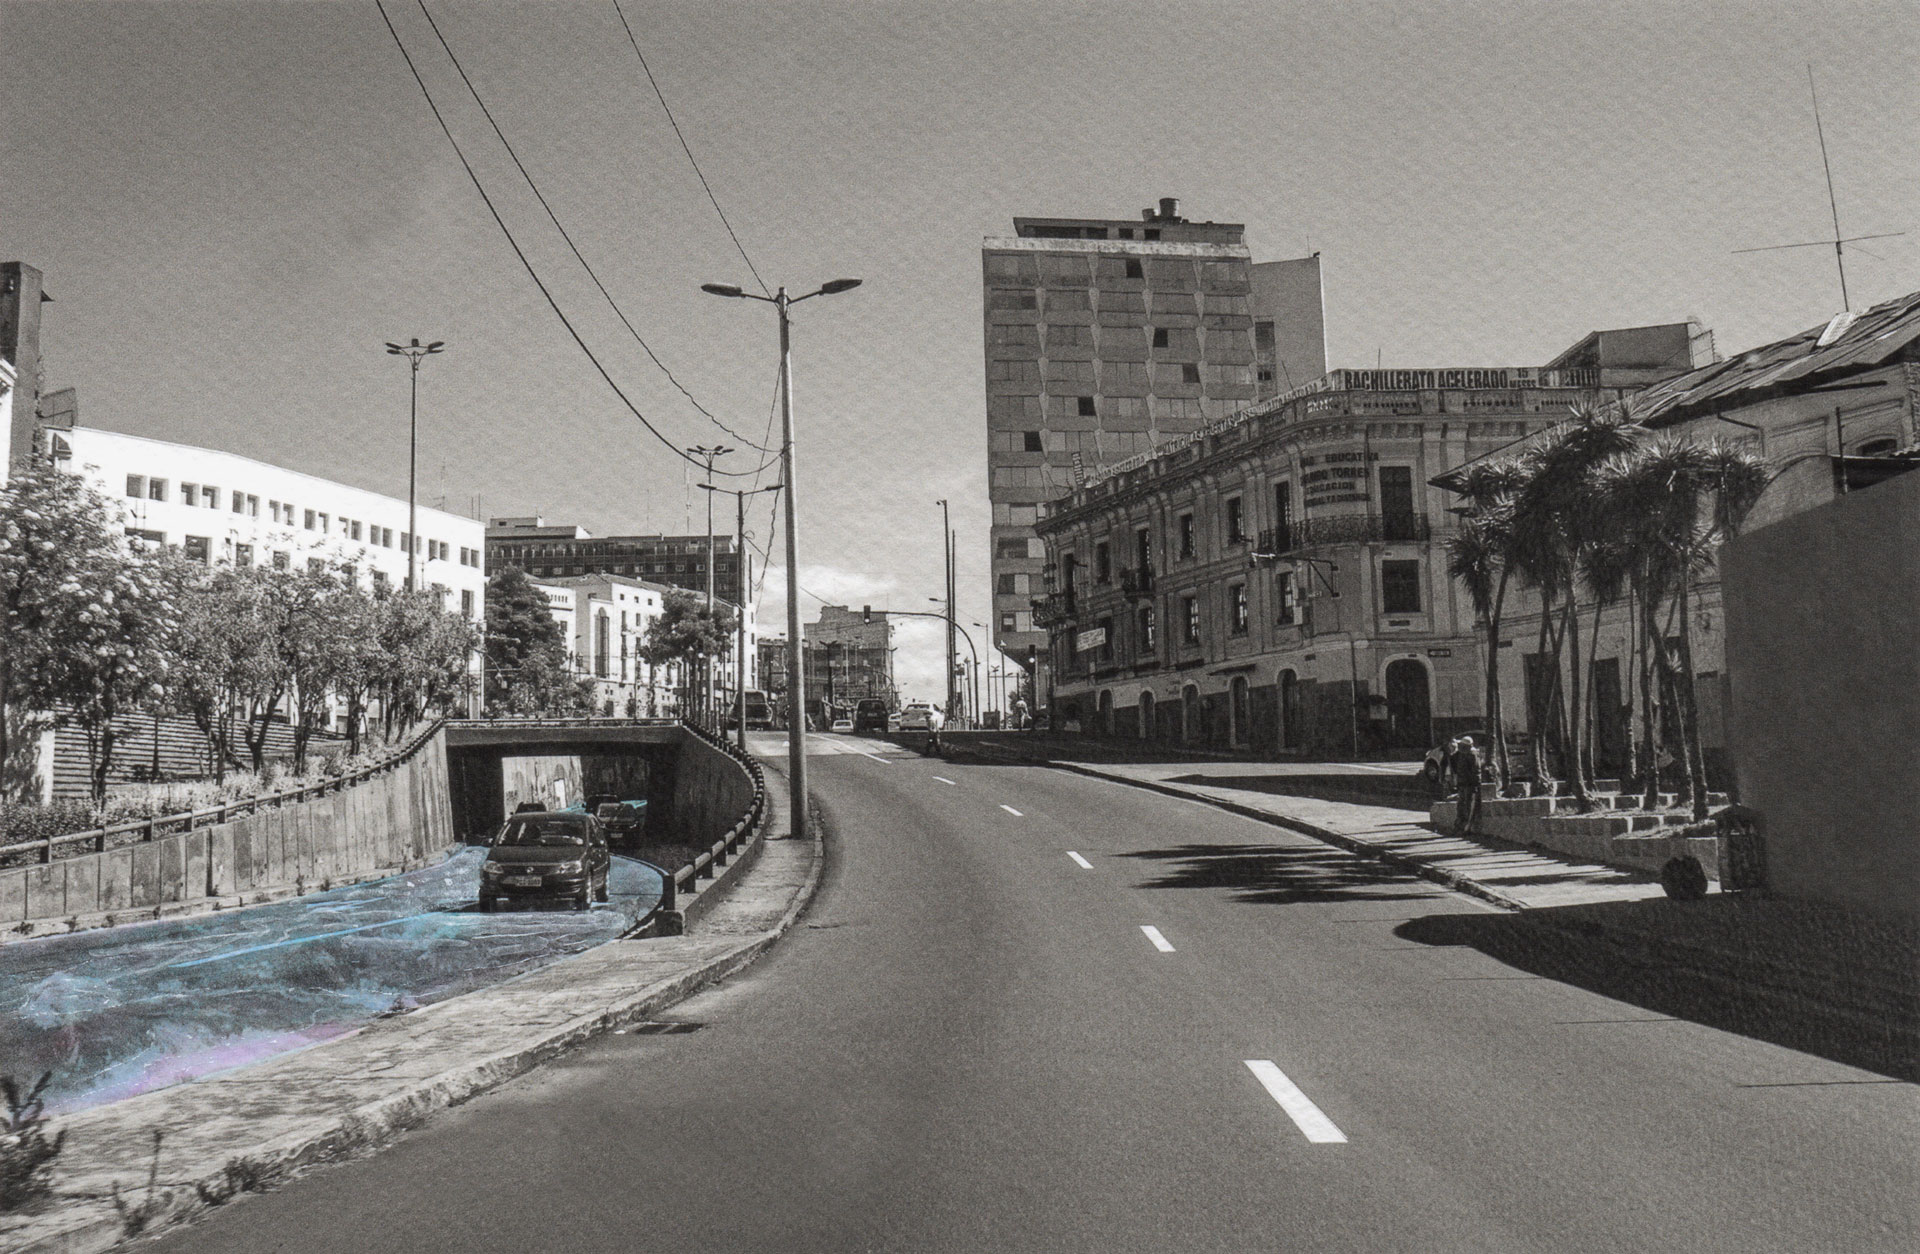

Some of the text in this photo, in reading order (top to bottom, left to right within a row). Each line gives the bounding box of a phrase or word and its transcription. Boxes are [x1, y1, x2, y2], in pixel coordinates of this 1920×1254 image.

[1517, 368, 1529, 378] 15
[1344, 369, 1508, 391] BACHILLERATO ACELERADO
[1325, 452, 1379, 463] EDUCATVA
